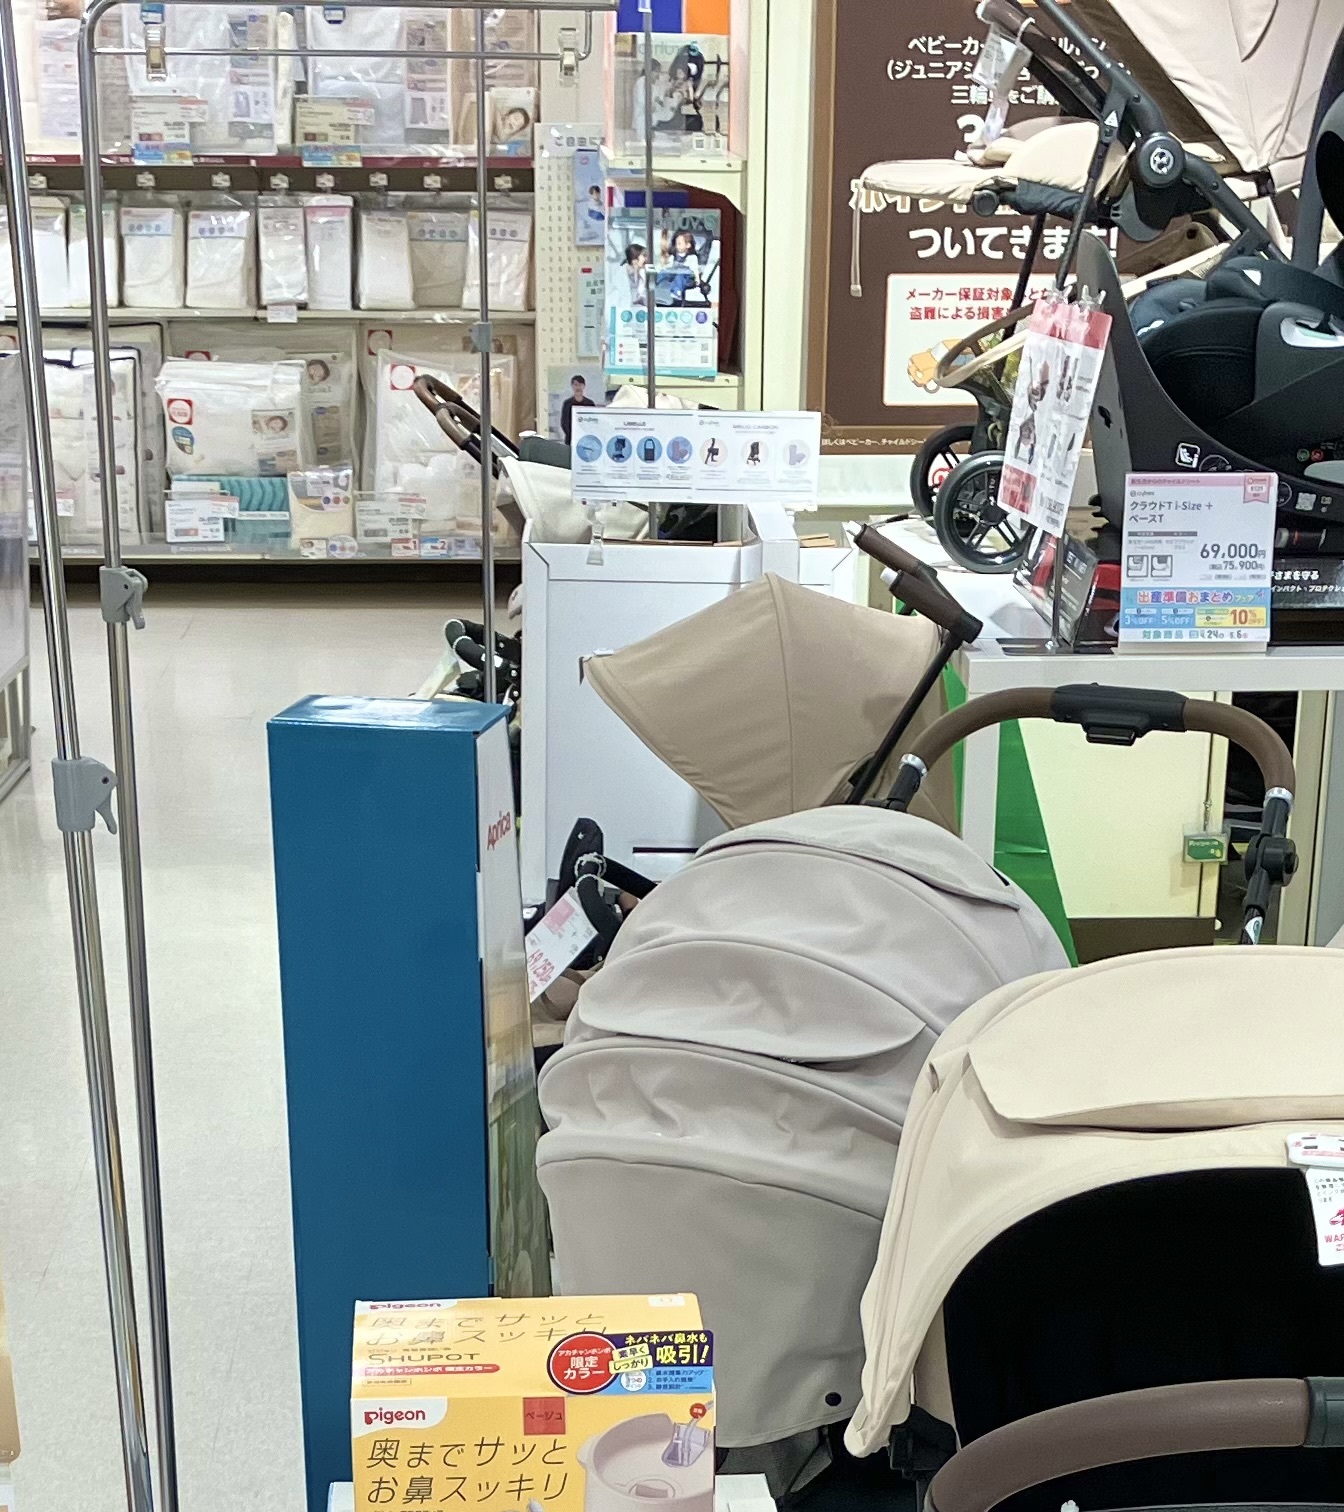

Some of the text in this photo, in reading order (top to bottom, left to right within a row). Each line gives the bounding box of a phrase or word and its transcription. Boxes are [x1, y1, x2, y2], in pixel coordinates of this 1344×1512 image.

[1175, 501, 1202, 510] i-Size
[1129, 514, 1163, 523] ベースT
[1200, 544, 1266, 559] 69,000円
[486, 811, 511, 851] Aprica
[369, 1301, 441, 1311] pigeon
[370, 1314, 605, 1328] 奥までサッと
[626, 1333, 708, 1345] ネバネバ鼻水も
[368, 1353, 481, 1363] SHUPOT
[657, 1345, 710, 1365] 吸引!
[571, 1357, 598, 1368] 限定
[614, 1358, 648, 1371] しっかり
[564, 1369, 605, 1380] カラー
[364, 1408, 426, 1425] pigeon
[525, 1410, 563, 1421] ベージュ
[366, 1438, 569, 1469] 奥までサッと
[366, 1473, 569, 1504] お鼻スッキリ
